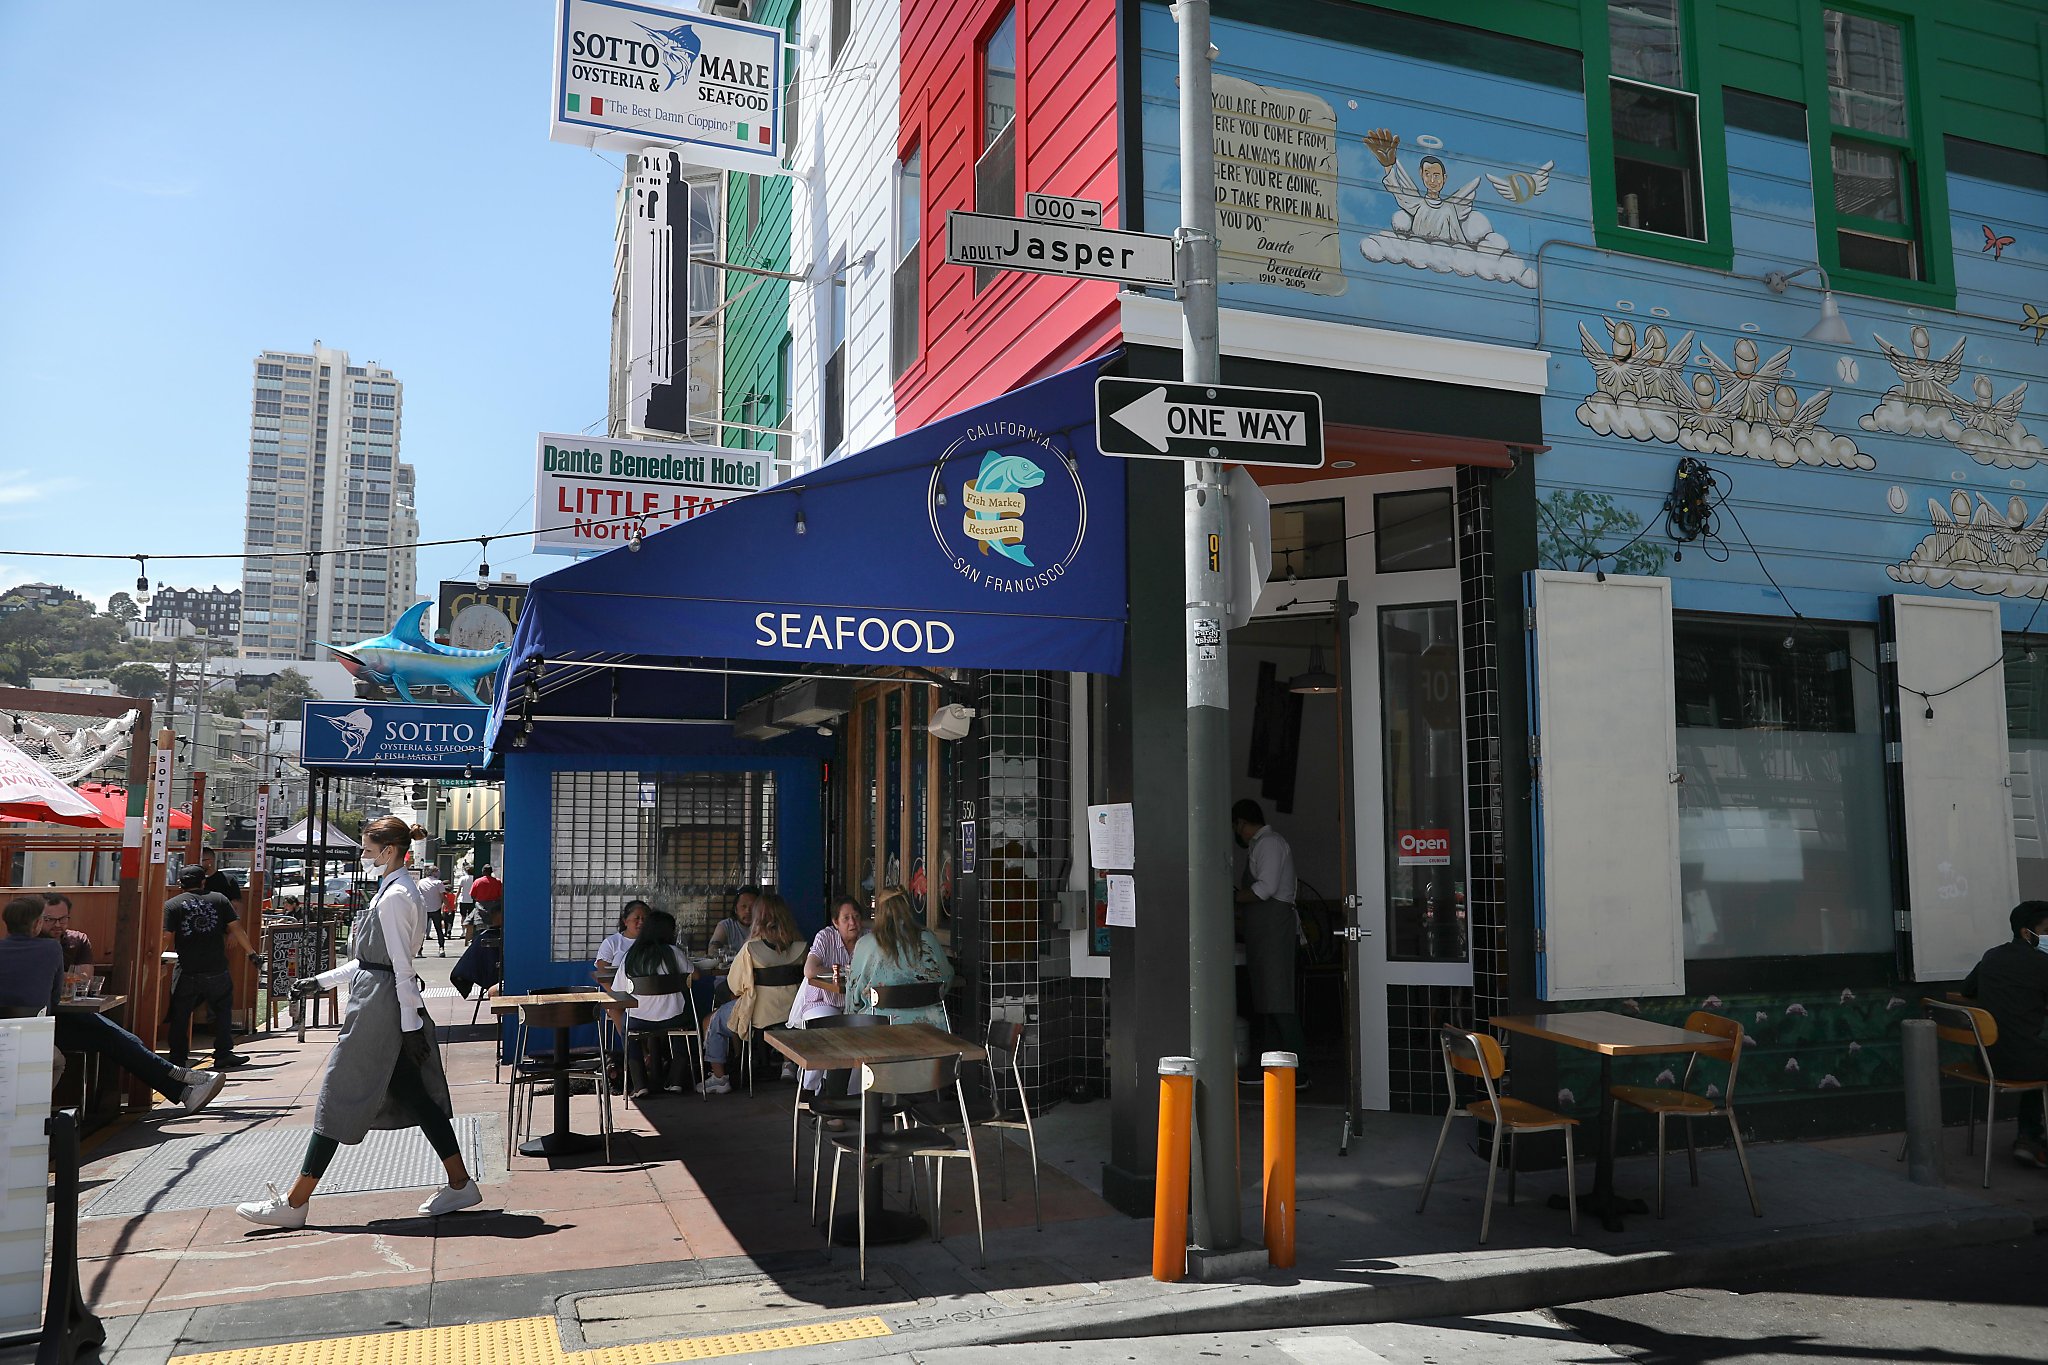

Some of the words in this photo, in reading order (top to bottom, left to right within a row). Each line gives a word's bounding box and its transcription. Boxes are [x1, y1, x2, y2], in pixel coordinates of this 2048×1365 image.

[572, 31, 660, 69] SOTTO
[699, 54, 769, 89] MARE
[572, 65, 644, 92] OYSTERIA
[649, 78, 660, 93] &
[698, 86, 769, 112] SEAFOOD
[632, 104, 651, 118] Best
[655, 108, 684, 124] Damn
[1212, 92, 1233, 110] YOU
[1237, 97, 1257, 115] ARE
[1261, 101, 1295, 121] PROUD
[1300, 107, 1313, 124] OF
[1239, 119, 1259, 138] YOU
[1264, 124, 1293, 145] COME
[1238, 142, 1280, 166] ALWAYS
[1285, 151, 1318, 173] KNOW
[1244, 166, 1284, 190] YOU'RE
[1231, 188, 1260, 208] TAKE
[1265, 194, 1299, 215] PRIDE
[1300, 200, 1312, 218] IN
[1315, 203, 1334, 222] ALL
[1220, 210, 1242, 230] YOU
[961, 245, 1002, 260] ADULT
[1003, 229, 1135, 271] Jasper
[1257, 236, 1295, 255] Dante
[1259, 273, 1277, 285] 1919
[1266, 258, 1325, 282] Benedetti
[966, 421, 1050, 450] CALIFORNIA
[1167, 406, 1227, 437] ONE
[1237, 410, 1297, 442] WAY
[543, 444, 603, 474] Dante
[609, 450, 706, 483] Benedetti
[711, 457, 761, 487] Hotel
[558, 486, 660, 520] LITTLE
[673, 494, 736, 521] ITA
[966, 493, 986, 507] Fish
[988, 494, 1022, 509] Market
[574, 517, 647, 541] North
[968, 523, 1018, 536] Restaurant
[953, 557, 981, 583] SAN
[985, 562, 1065, 593] FRANCISCO
[755, 612, 955, 654] SEAFOOD
[385, 721, 474, 743] SOTTO
[374, 752, 382, 760] &
[407, 753, 443, 761] MARKET
[380, 743, 423, 752] OYSTERIA
[434, 744, 475, 752] SEAFOOD
[963, 801, 975, 819] 550
[457, 832, 475, 841] 574
[1401, 834, 1447, 854] Open
[893, 1307, 1004, 1331] JASPER
